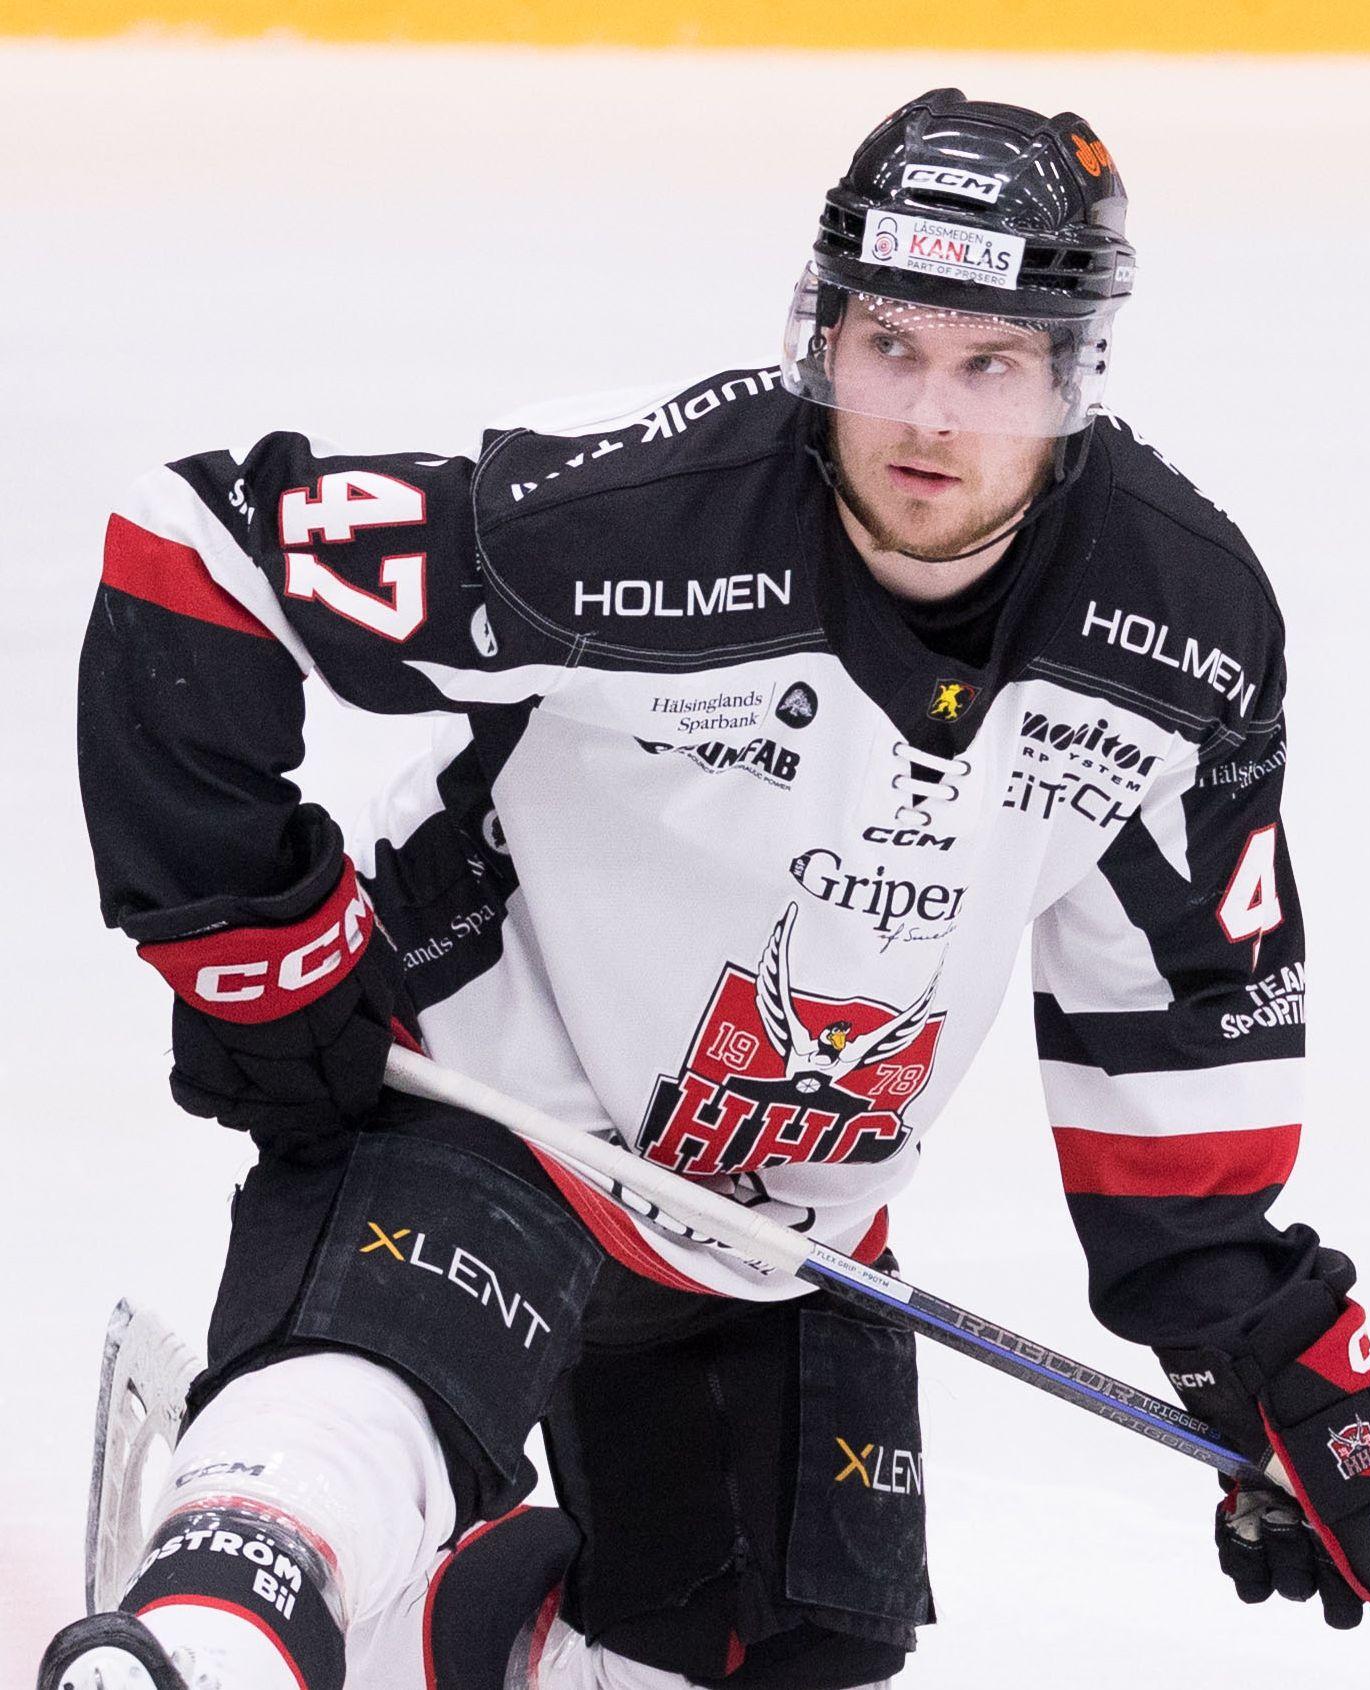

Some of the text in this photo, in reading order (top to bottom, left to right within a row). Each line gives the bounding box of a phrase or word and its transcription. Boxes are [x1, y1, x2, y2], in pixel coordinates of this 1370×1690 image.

[907, 169, 999, 194] CCM
[907, 259, 933, 273] PART
[936, 265, 953, 275] OF
[909, 234, 1011, 271] KANLÅS
[277, 469, 428, 644] 47
[573, 568, 793, 617] HOLMEN
[1081, 600, 1256, 719] HOLMEN
[650, 690, 764, 715] Hälsinglands
[676, 711, 760, 735] Sparbank
[1022, 746, 1142, 793] RP YSTEM
[861, 825, 958, 852] CCM
[705, 1020, 760, 1072] 19
[867, 1063, 925, 1097] 78
[358, 1220, 552, 1350] XLENT
[1137, 1393, 1210, 1436] TRIGGER
[174, 1461, 267, 1490] CCM
[834, 1436, 923, 1496] XLEN
[252, 1568, 297, 1622] Bil
